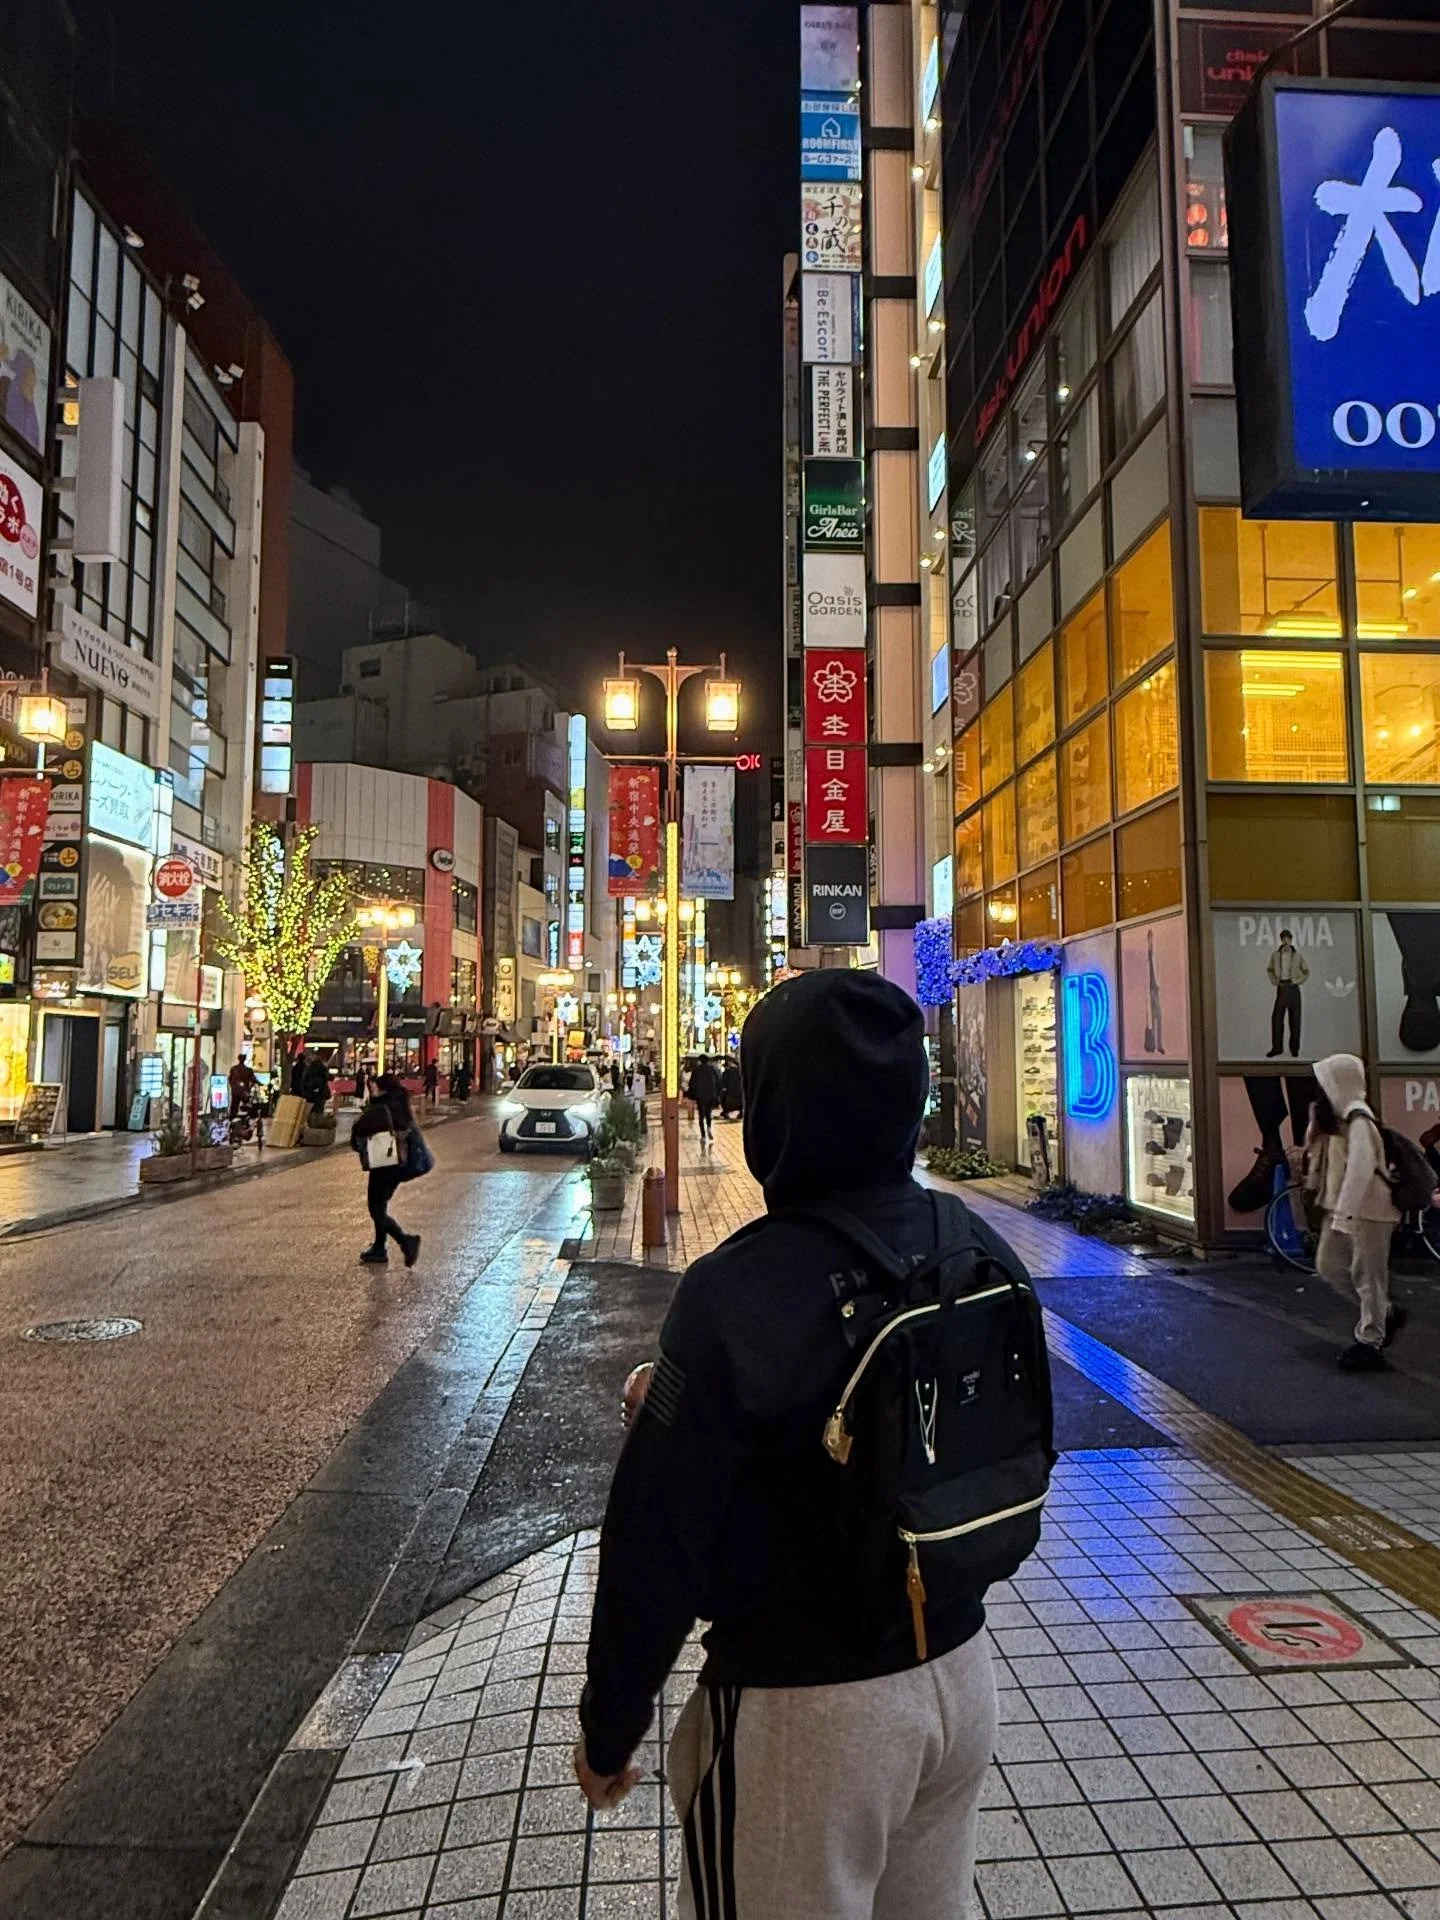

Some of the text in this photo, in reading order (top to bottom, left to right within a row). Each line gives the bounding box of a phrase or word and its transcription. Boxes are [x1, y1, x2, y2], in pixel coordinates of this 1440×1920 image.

[821, 195, 849, 254] 千の蔵
[1007, 213, 1087, 383] union
[818, 370, 830, 386] THE
[818, 390, 830, 430] PERFECT
[808, 591, 862, 606] Oasis
[74, 639, 129, 689] NUEVO
[158, 871, 191, 887] 消火栓
[812, 884, 863, 897] RINKAN
[1062, 972, 1119, 1121] B
